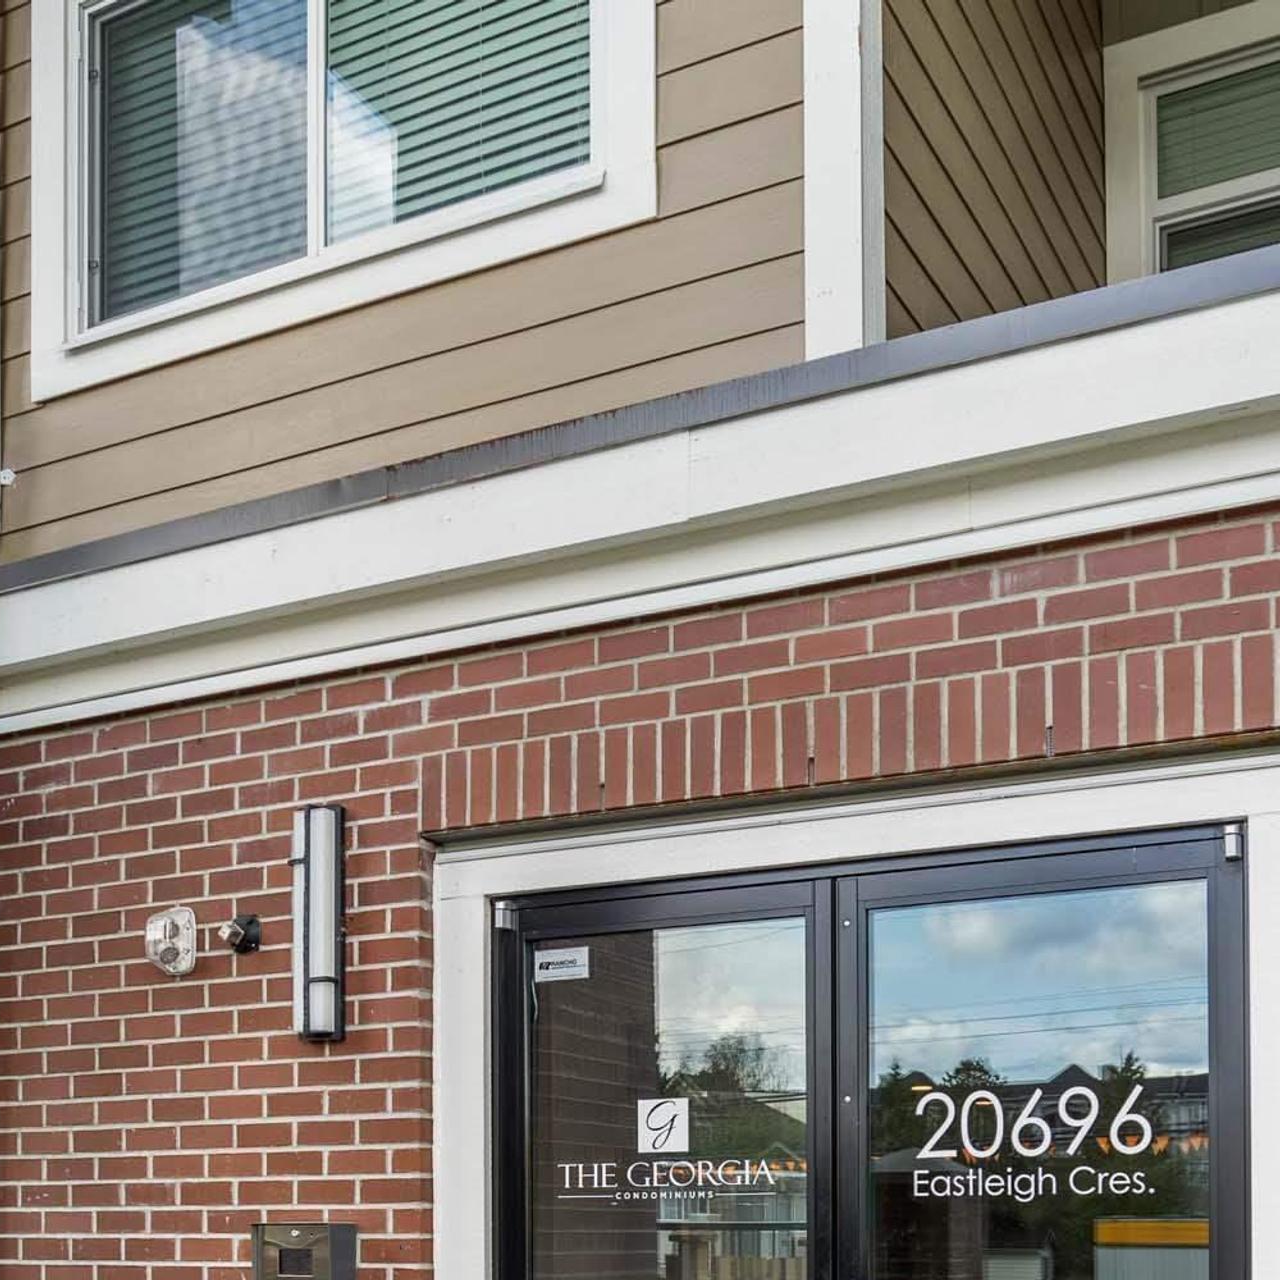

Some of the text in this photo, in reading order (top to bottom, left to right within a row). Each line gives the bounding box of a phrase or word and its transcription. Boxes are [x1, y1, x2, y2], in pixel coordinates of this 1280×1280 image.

[915, 1084, 1153, 1160] 20696
[557, 1158, 776, 1189] THE GEORGIA
[912, 1165, 1156, 1203] Eastleigh Cres.
[615, 1190, 715, 1200] CONDOMINIUMS
